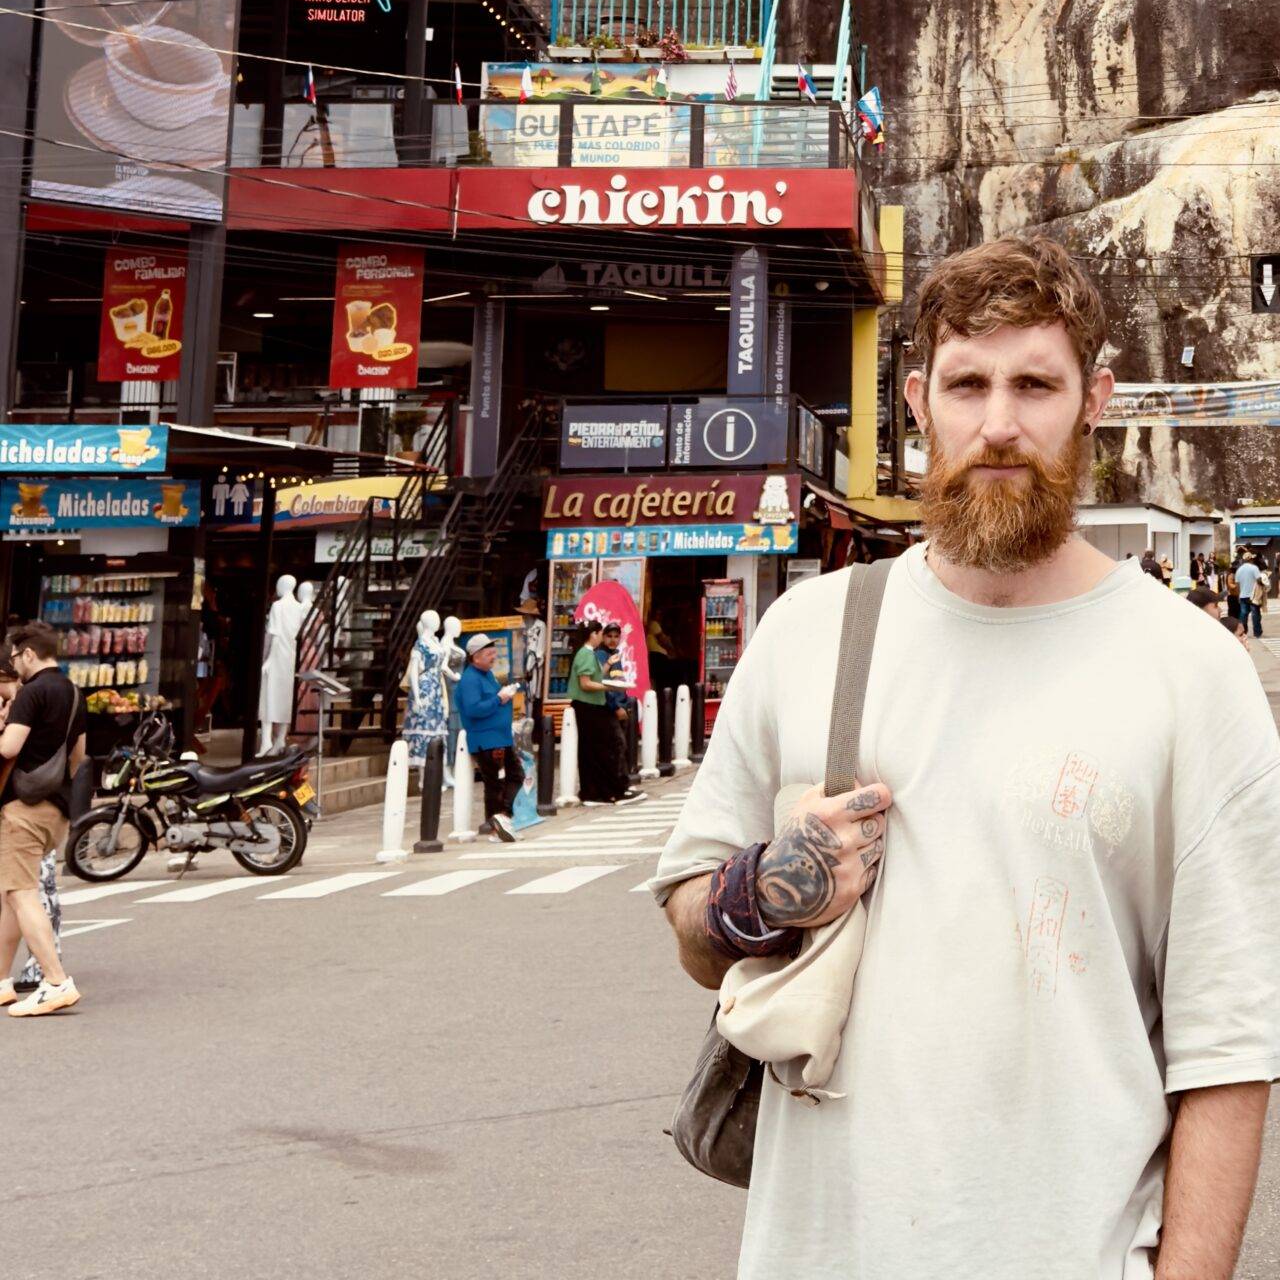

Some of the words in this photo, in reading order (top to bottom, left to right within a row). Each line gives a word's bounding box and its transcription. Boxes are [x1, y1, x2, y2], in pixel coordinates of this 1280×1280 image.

[307, 8, 366, 22] SIMULATOR
[519, 112, 661, 138] GUTAPÉ
[579, 140, 602, 150] MAS
[604, 140, 661, 151] COLORIDO
[580, 153, 620, 164] MUNDO
[113, 256, 157, 272] COMBO
[737, 275, 756, 375] TAQUILLA
[568, 422, 615, 437] PIEDRA
[623, 419, 664, 437] PEÑOL
[674, 422, 684, 439] de
[683, 407, 693, 464] Información
[581, 435, 651, 448] ENTERTAINMENT
[674, 441, 684, 464] Punto
[57, 491, 150, 518] Micheladas
[290, 493, 382, 517] Colombians
[543, 484, 586, 519] La
[593, 479, 737, 527] cafetería
[673, 531, 734, 550] Micheladas
